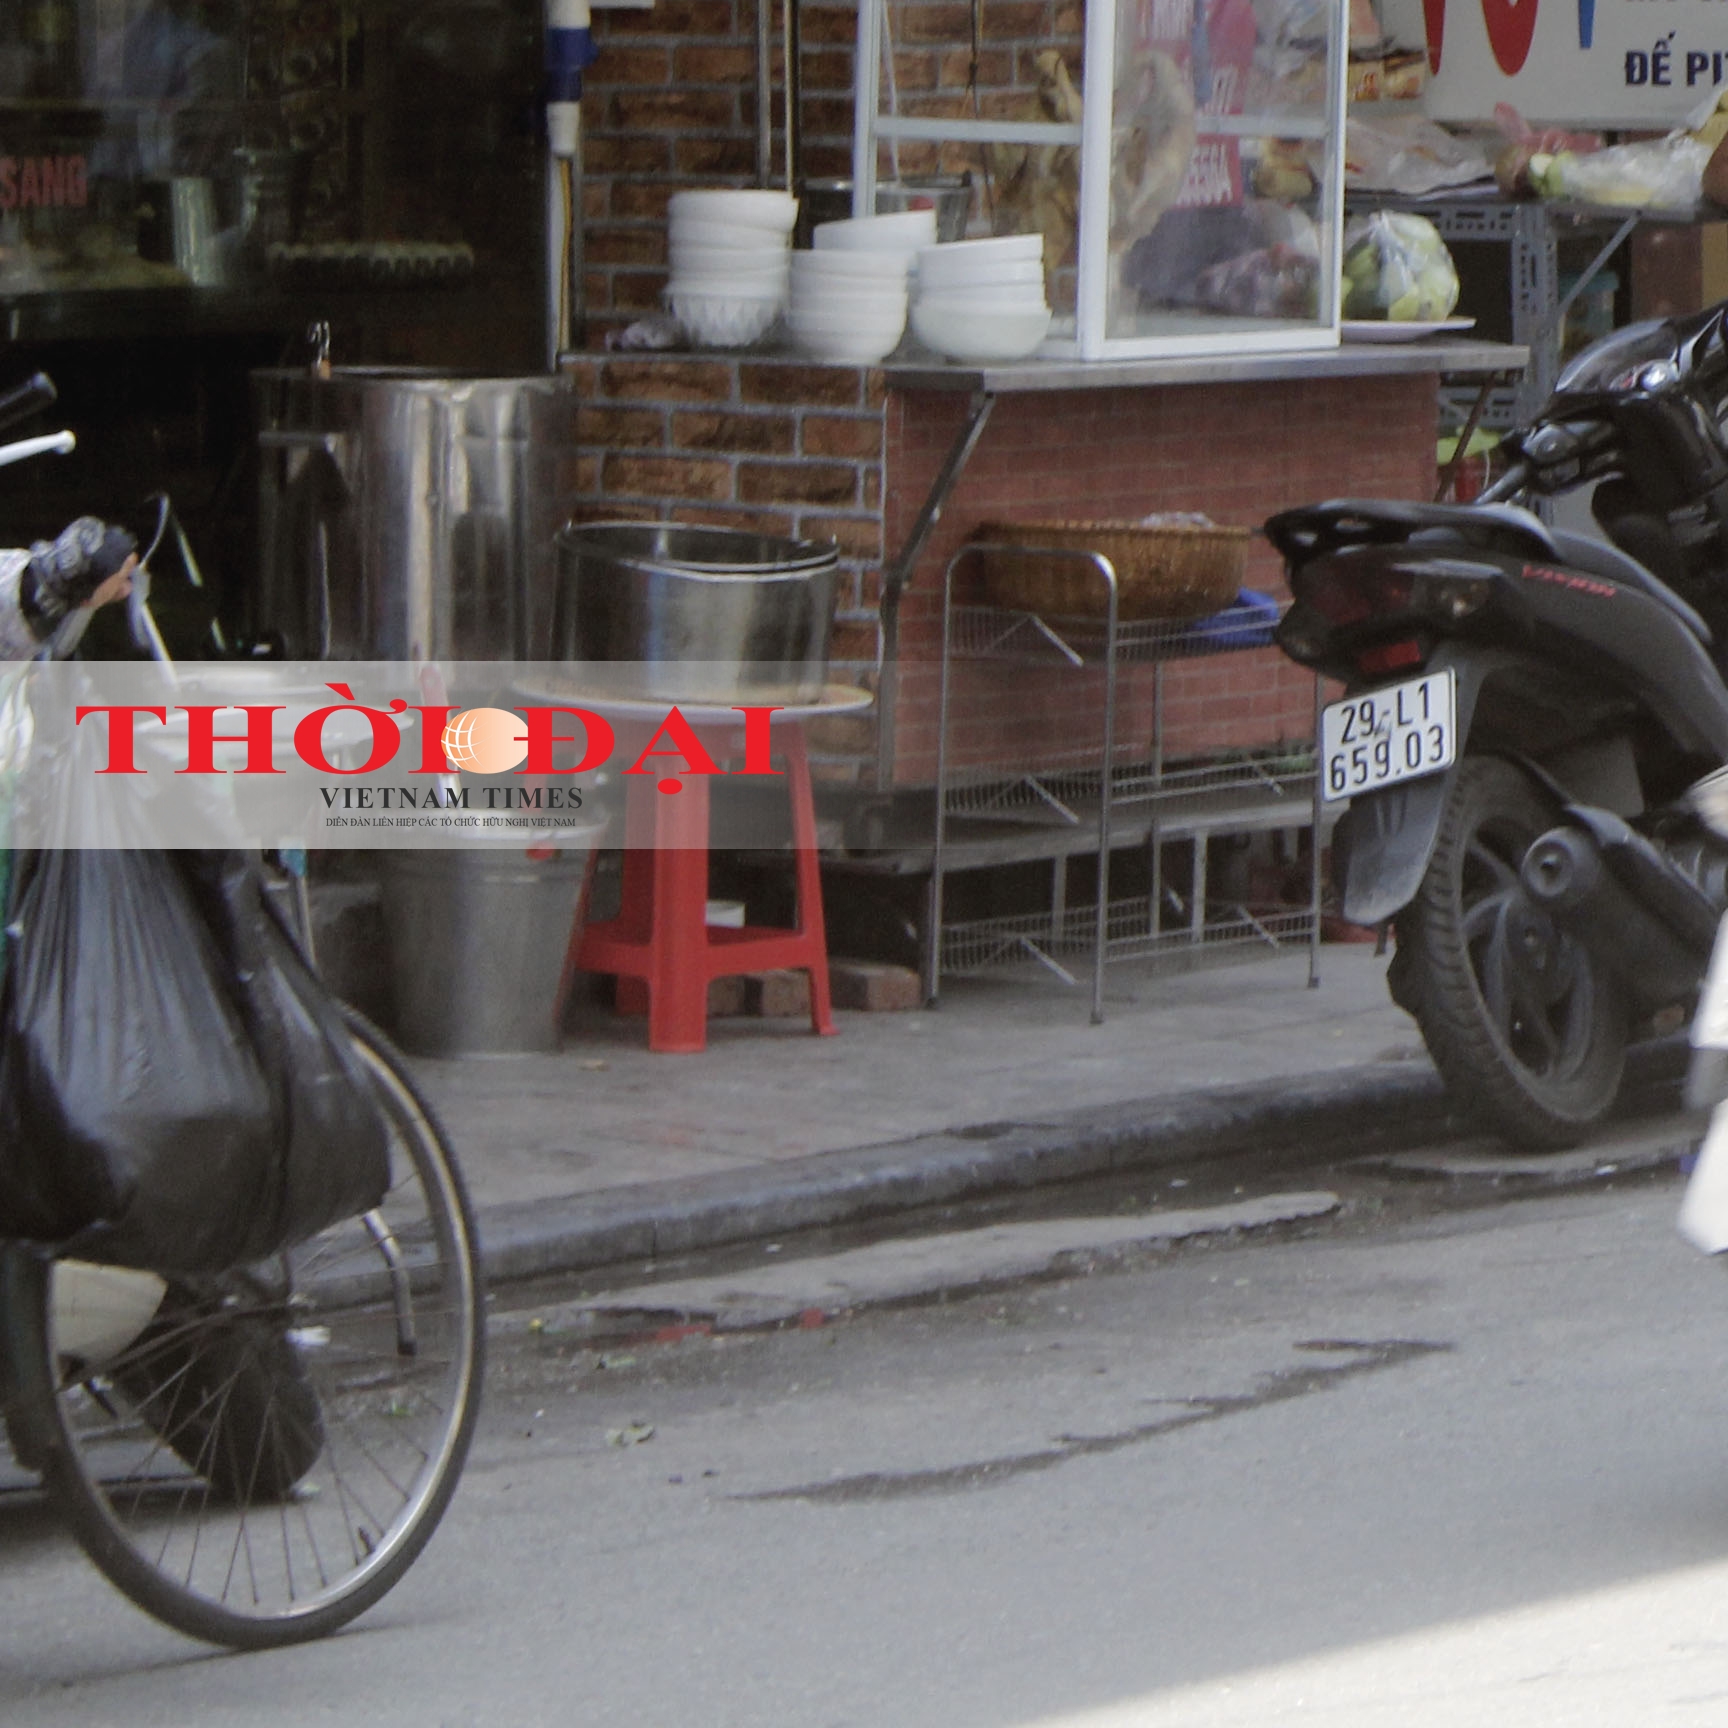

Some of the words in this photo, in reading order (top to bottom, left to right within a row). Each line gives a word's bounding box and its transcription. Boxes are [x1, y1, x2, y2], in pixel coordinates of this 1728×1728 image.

[1624, 29, 1675, 87] ĐẾ
[1340, 680, 1431, 745] 29-L1
[1330, 724, 1445, 792] 659.03
